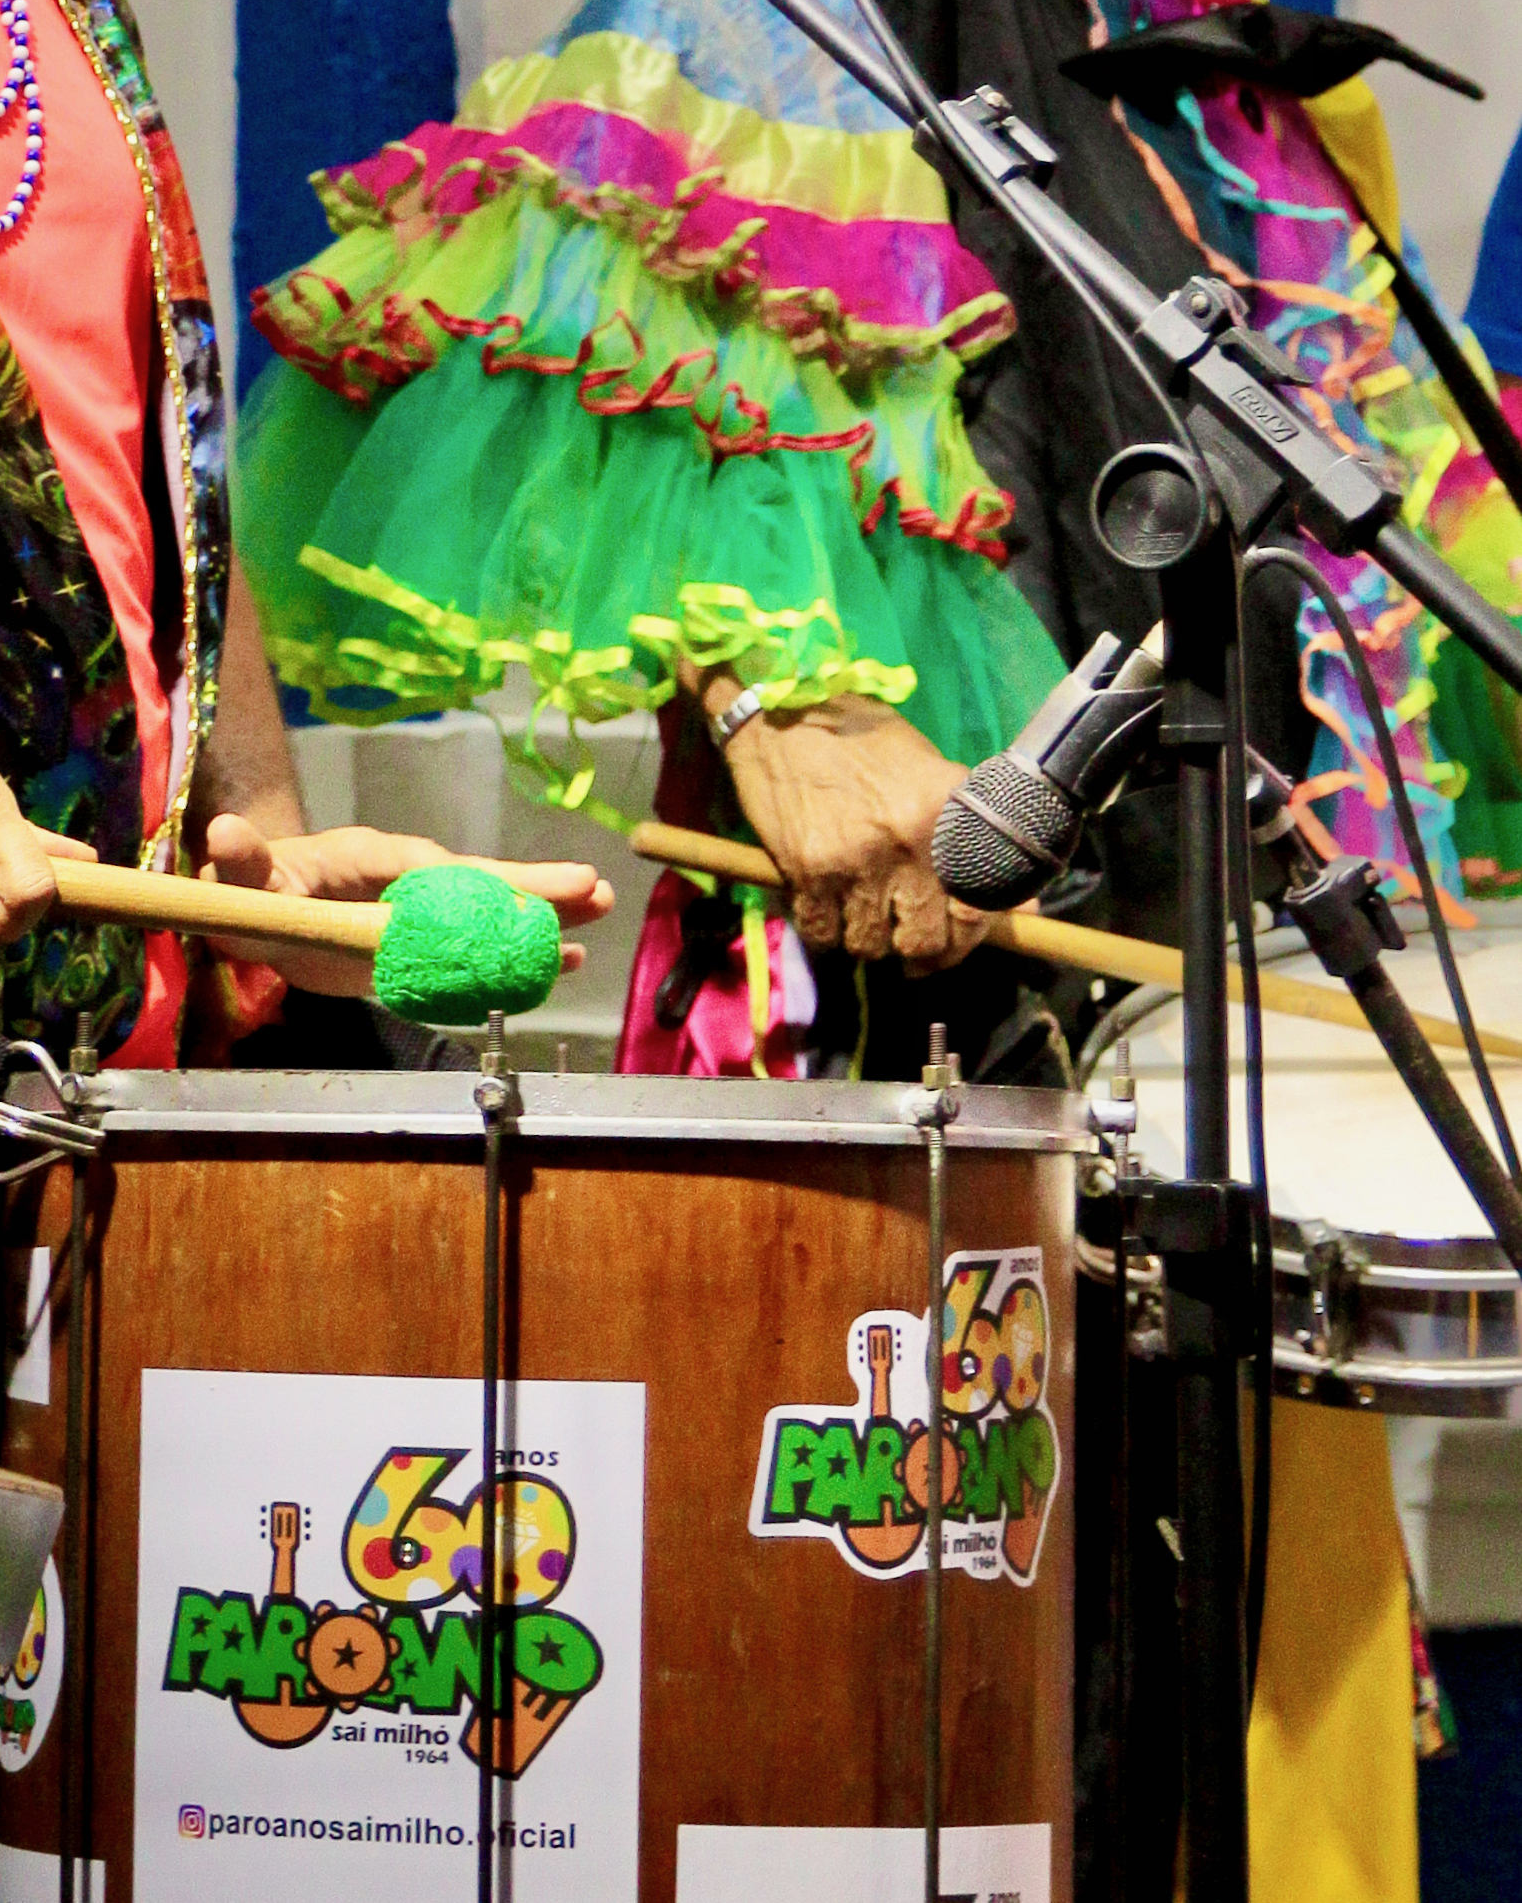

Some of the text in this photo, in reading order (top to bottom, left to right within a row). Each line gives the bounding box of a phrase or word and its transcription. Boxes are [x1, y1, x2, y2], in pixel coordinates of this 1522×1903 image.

[341, 1446, 577, 1610] 60
[163, 1586, 604, 1720] PAROANO
[331, 1722, 450, 1746] sai milhó
[405, 1749, 449, 1764] 1964
